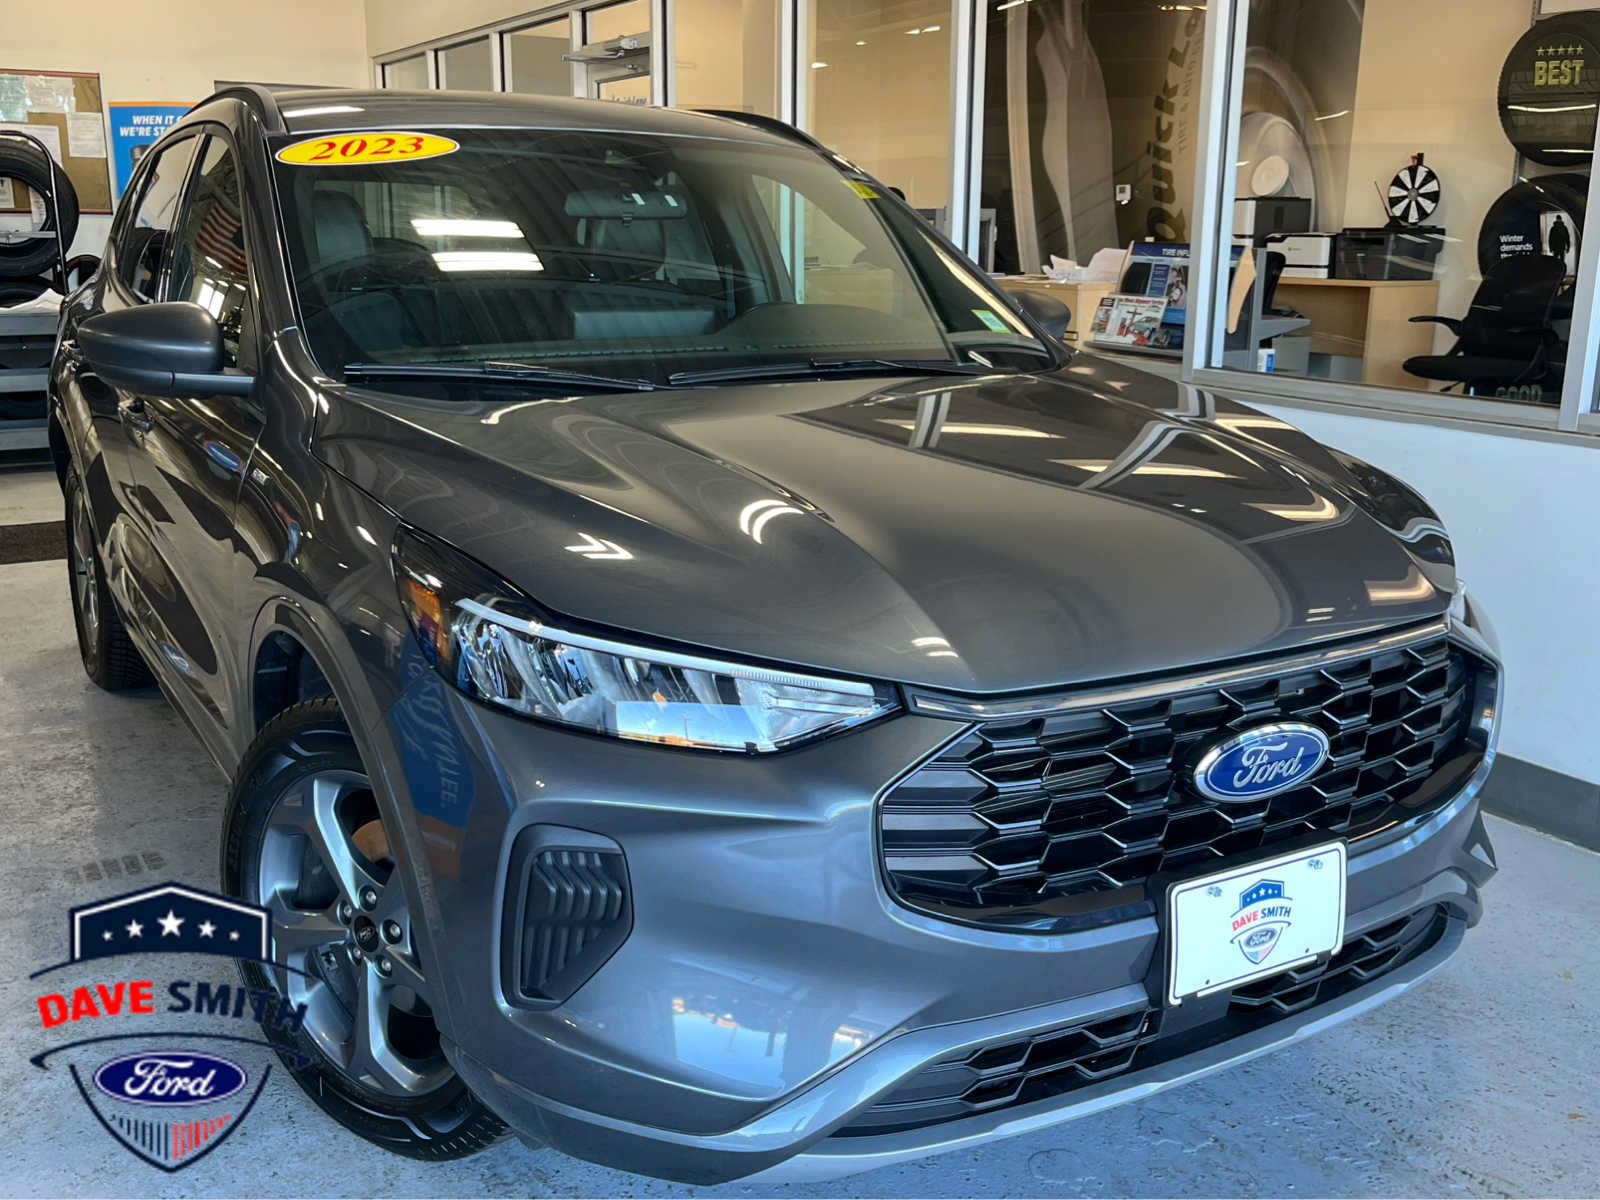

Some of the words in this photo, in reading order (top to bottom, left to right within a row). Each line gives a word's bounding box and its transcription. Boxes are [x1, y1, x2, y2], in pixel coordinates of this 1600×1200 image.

[1534, 59, 1584, 87] BEST
[120, 126, 151, 137] WE'RE
[132, 115, 162, 125] WHEN
[165, 115, 174, 125] IT
[308, 136, 424, 161] 2023
[1147, 78, 1187, 242] Quick
[1500, 243, 1533, 251] demands
[1233, 742, 1304, 788] Ford
[1232, 910, 1259, 931] DAVE
[1260, 905, 1292, 919] SMITH
